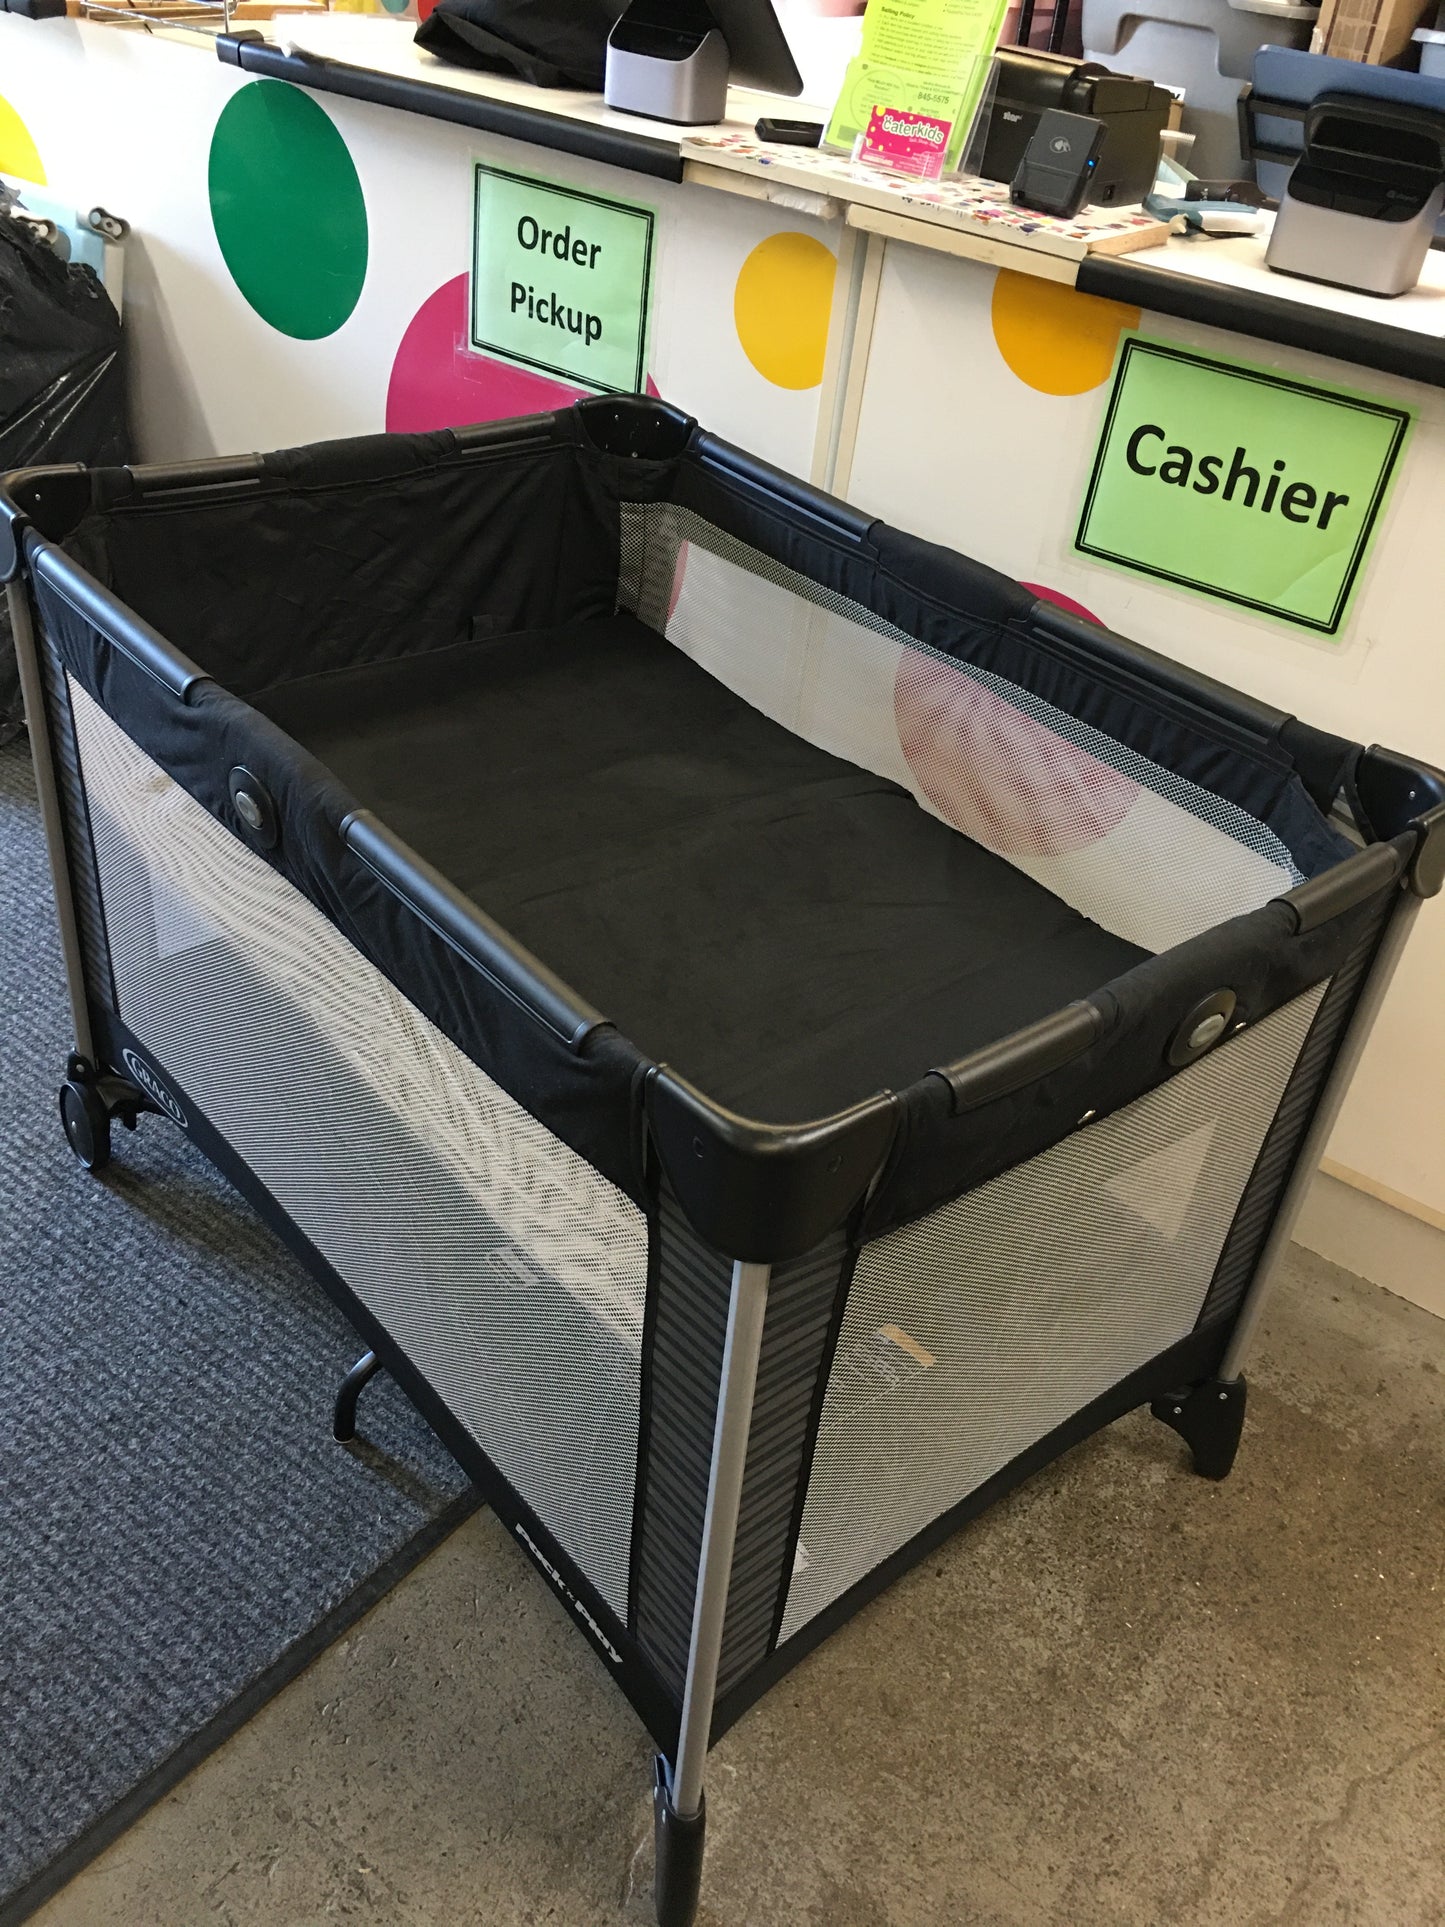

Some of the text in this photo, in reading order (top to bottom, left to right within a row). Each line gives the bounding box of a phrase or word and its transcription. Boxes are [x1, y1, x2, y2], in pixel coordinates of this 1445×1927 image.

[517, 215, 602, 269] Order
[510, 281, 602, 346] Pickup
[1125, 423, 1350, 530] Cashier
[131, 1057, 181, 1119] GRACO
